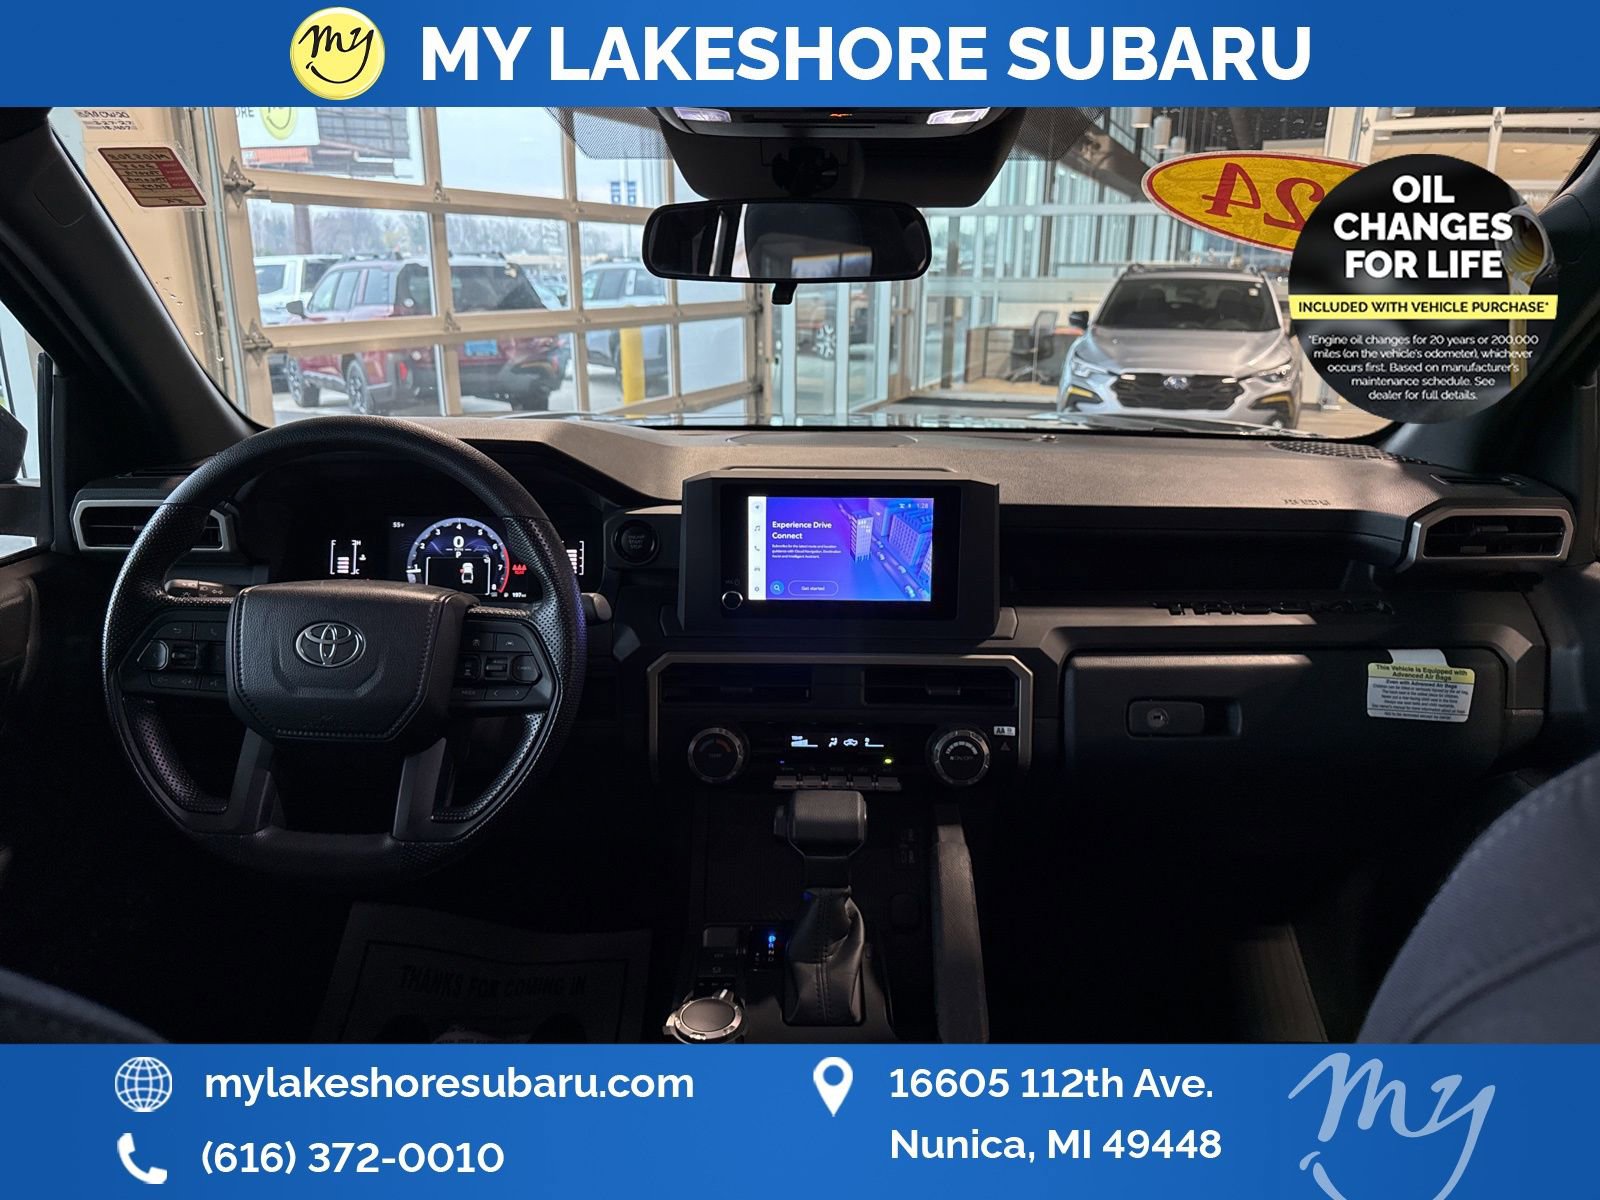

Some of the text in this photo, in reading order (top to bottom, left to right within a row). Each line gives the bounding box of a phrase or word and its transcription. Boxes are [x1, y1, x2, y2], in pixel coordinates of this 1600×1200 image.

[772, 520, 832, 530] Experience Drive
[772, 531, 803, 540] Connect
[419, 542, 426, 550] 2
[453, 536, 465, 548] 0
[1391, 664, 1414, 672] Vehicle
[1422, 667, 1453, 675] Equipped
[1392, 671, 1424, 679] Advanced
